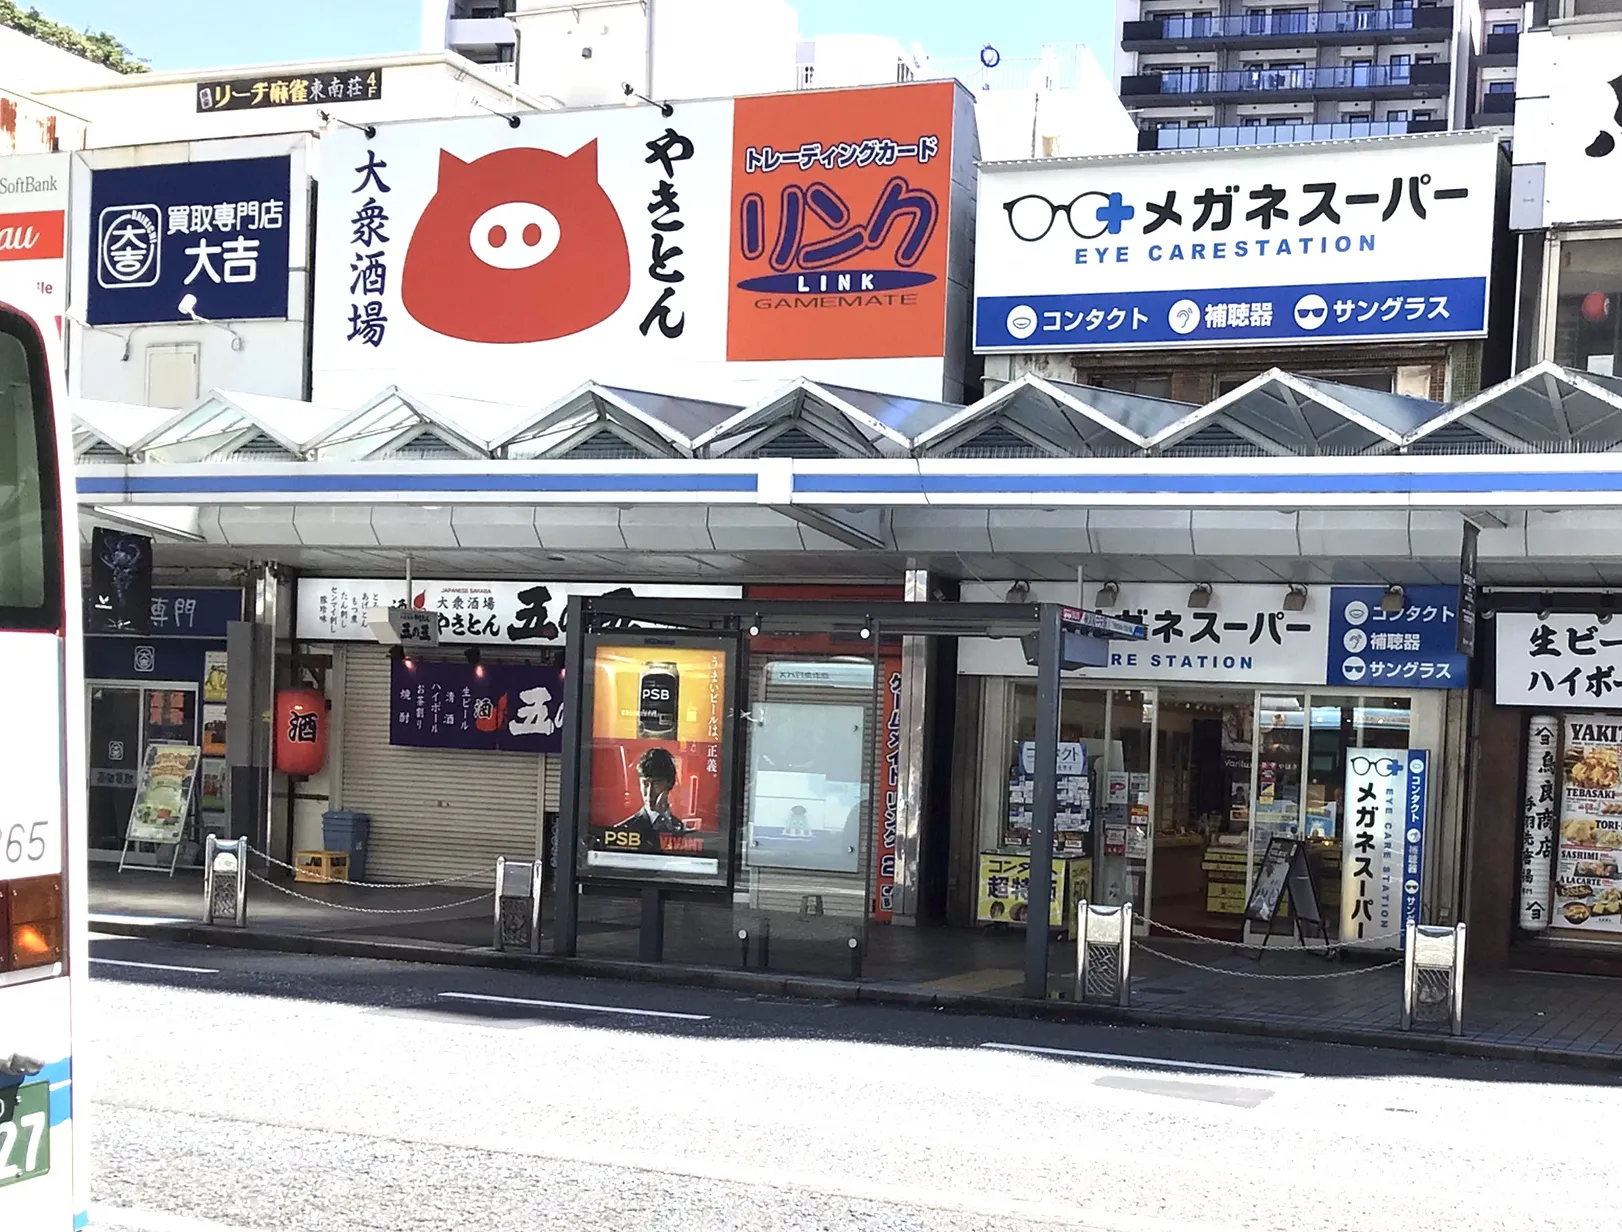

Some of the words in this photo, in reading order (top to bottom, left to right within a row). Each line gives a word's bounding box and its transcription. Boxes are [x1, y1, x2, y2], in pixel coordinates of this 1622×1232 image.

[745, 134, 939, 173] トレーディングカード
[0, 175, 58, 194] SoftBank
[167, 199, 283, 236] 買取専門店
[1142, 173, 1469, 234] メガネスーパー
[0, 225, 40, 251] au
[130, 209, 158, 244] DAIKICHI
[639, 128, 695, 339] やきとん
[739, 176, 940, 273] リンク
[183, 235, 260, 286] 大吉
[347, 150, 391, 348] 大衆酒場
[1074, 246, 1130, 265] EYE
[796, 273, 876, 293] LINK
[754, 293, 918, 310] GAMEMATE
[1042, 307, 1149, 333] コンタクト
[1204, 302, 1274, 330] 補聴器
[1333, 295, 1451, 323] サングラス
[437, 596, 495, 611] 大衆酒場
[1370, 632, 1421, 651] 補聴器
[1150, 654, 1253, 669] STATION
[1369, 661, 1452, 679] サングラス
[642, 689, 670, 700] PSB
[287, 710, 319, 744] 酒
[1224, 758, 1254, 769] Varilu
[1385, 788, 1394, 814] EYE
[1410, 776, 1421, 823] コンタクト
[1566, 788, 1615, 799] TEBASAKI
[0, 820, 48, 863] 65
[604, 830, 641, 847] PSB
[1383, 822, 1393, 859] CARE
[1351, 782, 1378, 939] メガネスーパー
[1561, 850, 1599, 861] SASHIMI
[1380, 866, 1391, 929] STATION
